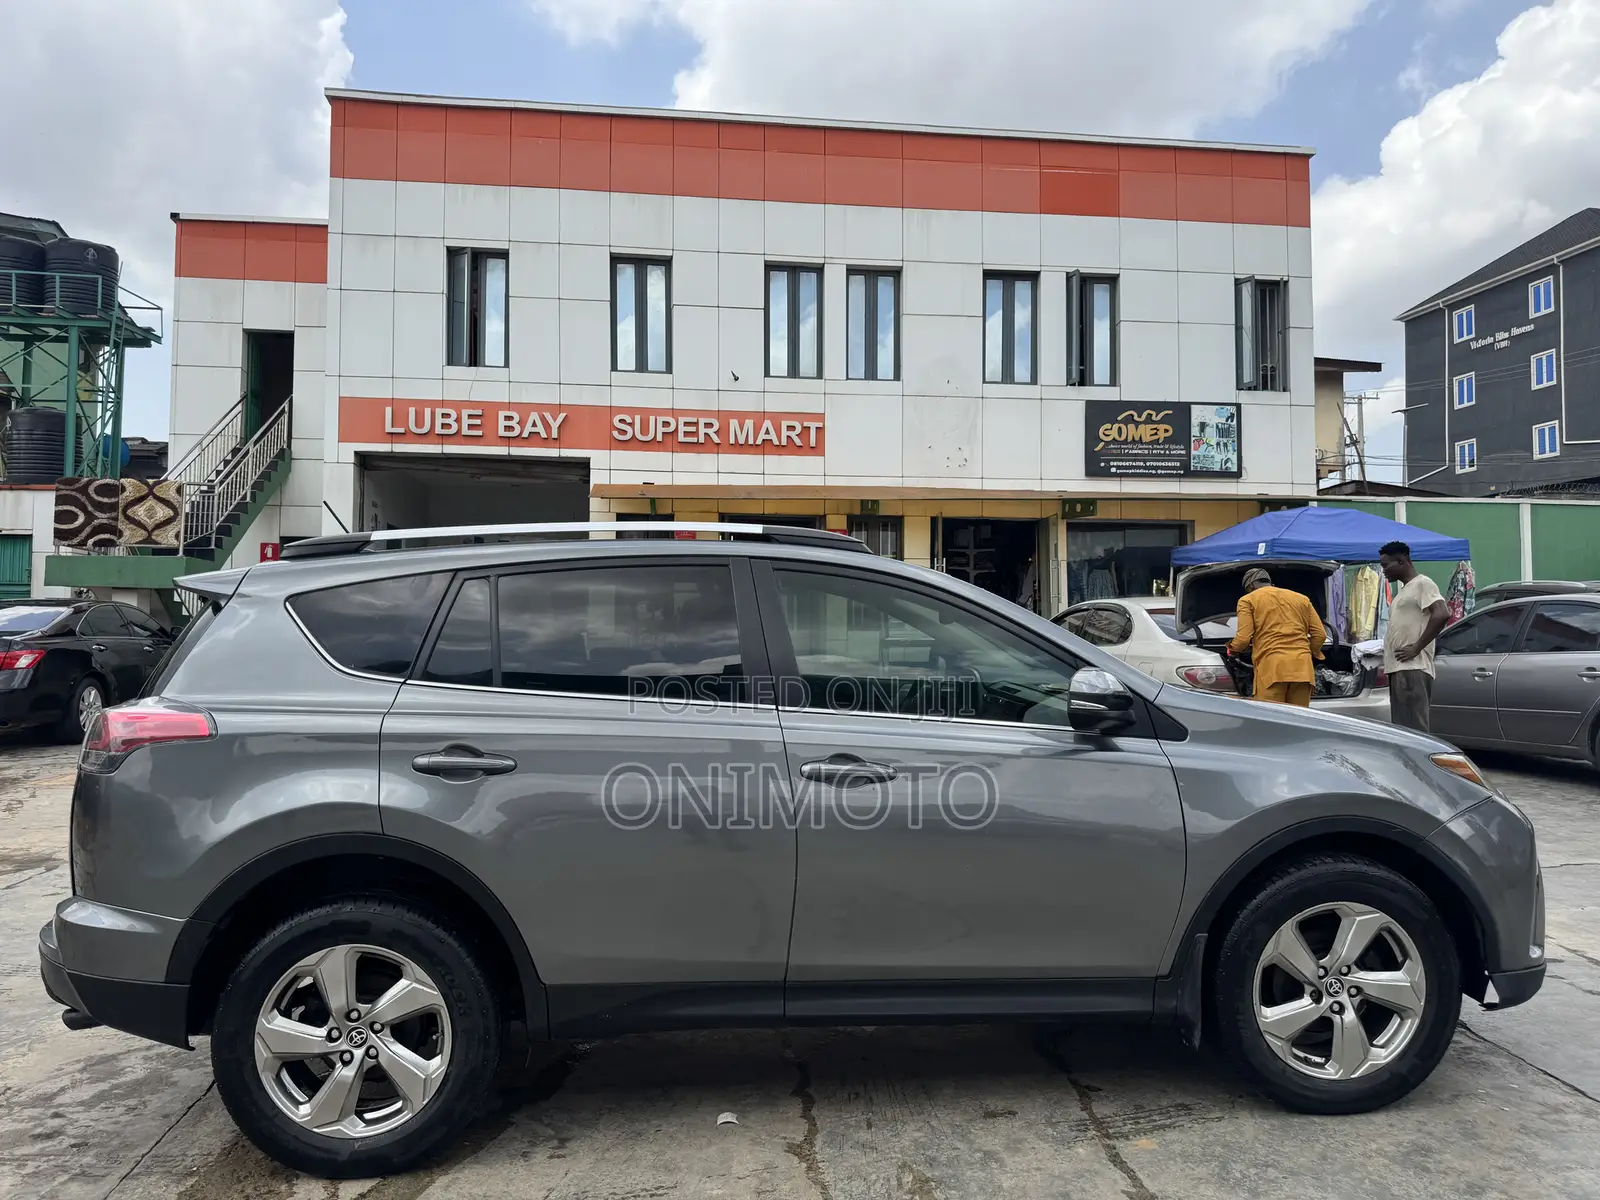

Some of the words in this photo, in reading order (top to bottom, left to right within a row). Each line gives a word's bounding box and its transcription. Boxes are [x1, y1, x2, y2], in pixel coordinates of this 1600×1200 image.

[1470, 336, 1494, 350] Victoria
[1495, 331, 1510, 342] Bliss
[1510, 323, 1535, 337] Havens
[384, 406, 484, 437] LUBE
[497, 410, 567, 440] BAY
[611, 413, 721, 445] SUPER
[728, 418, 823, 449] MART
[1098, 423, 1174, 444] GOMEP
